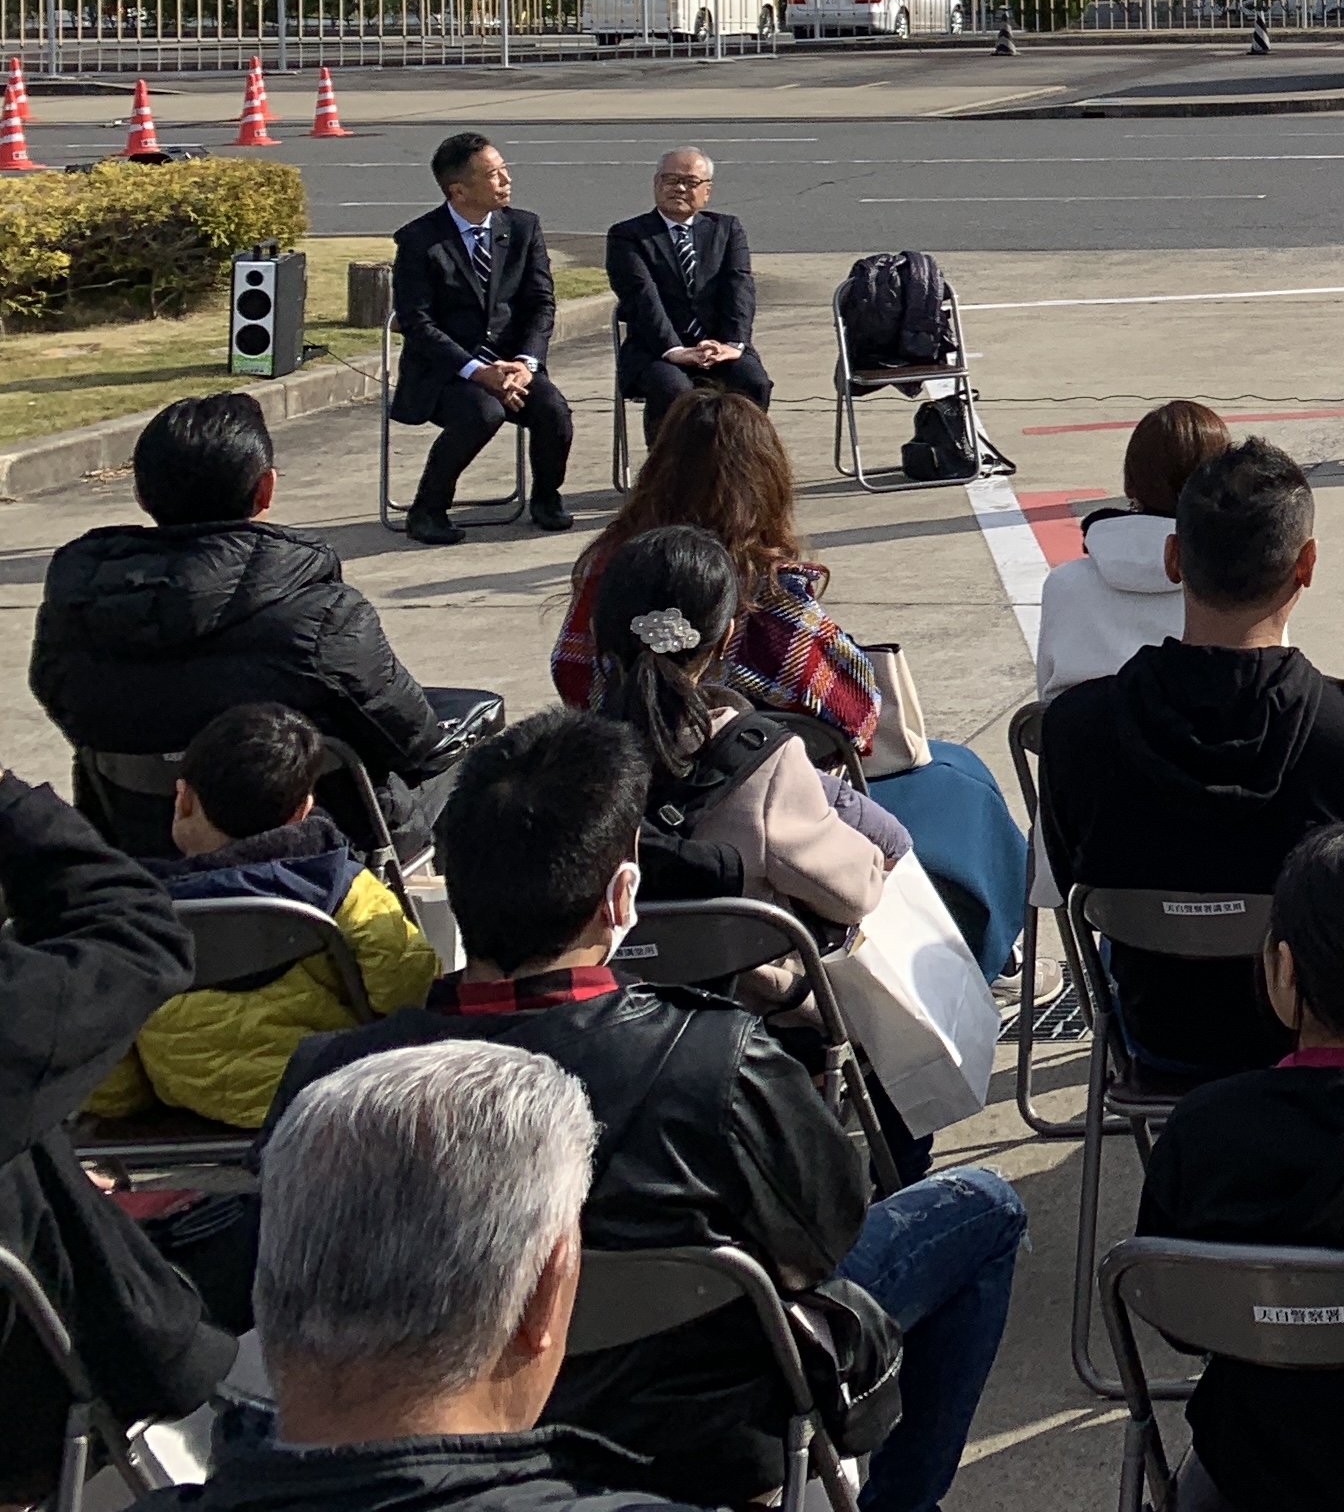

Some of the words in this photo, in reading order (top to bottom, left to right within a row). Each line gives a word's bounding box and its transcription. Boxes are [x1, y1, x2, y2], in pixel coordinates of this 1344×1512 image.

[1259, 1308, 1341, 1323] 天白警察署
